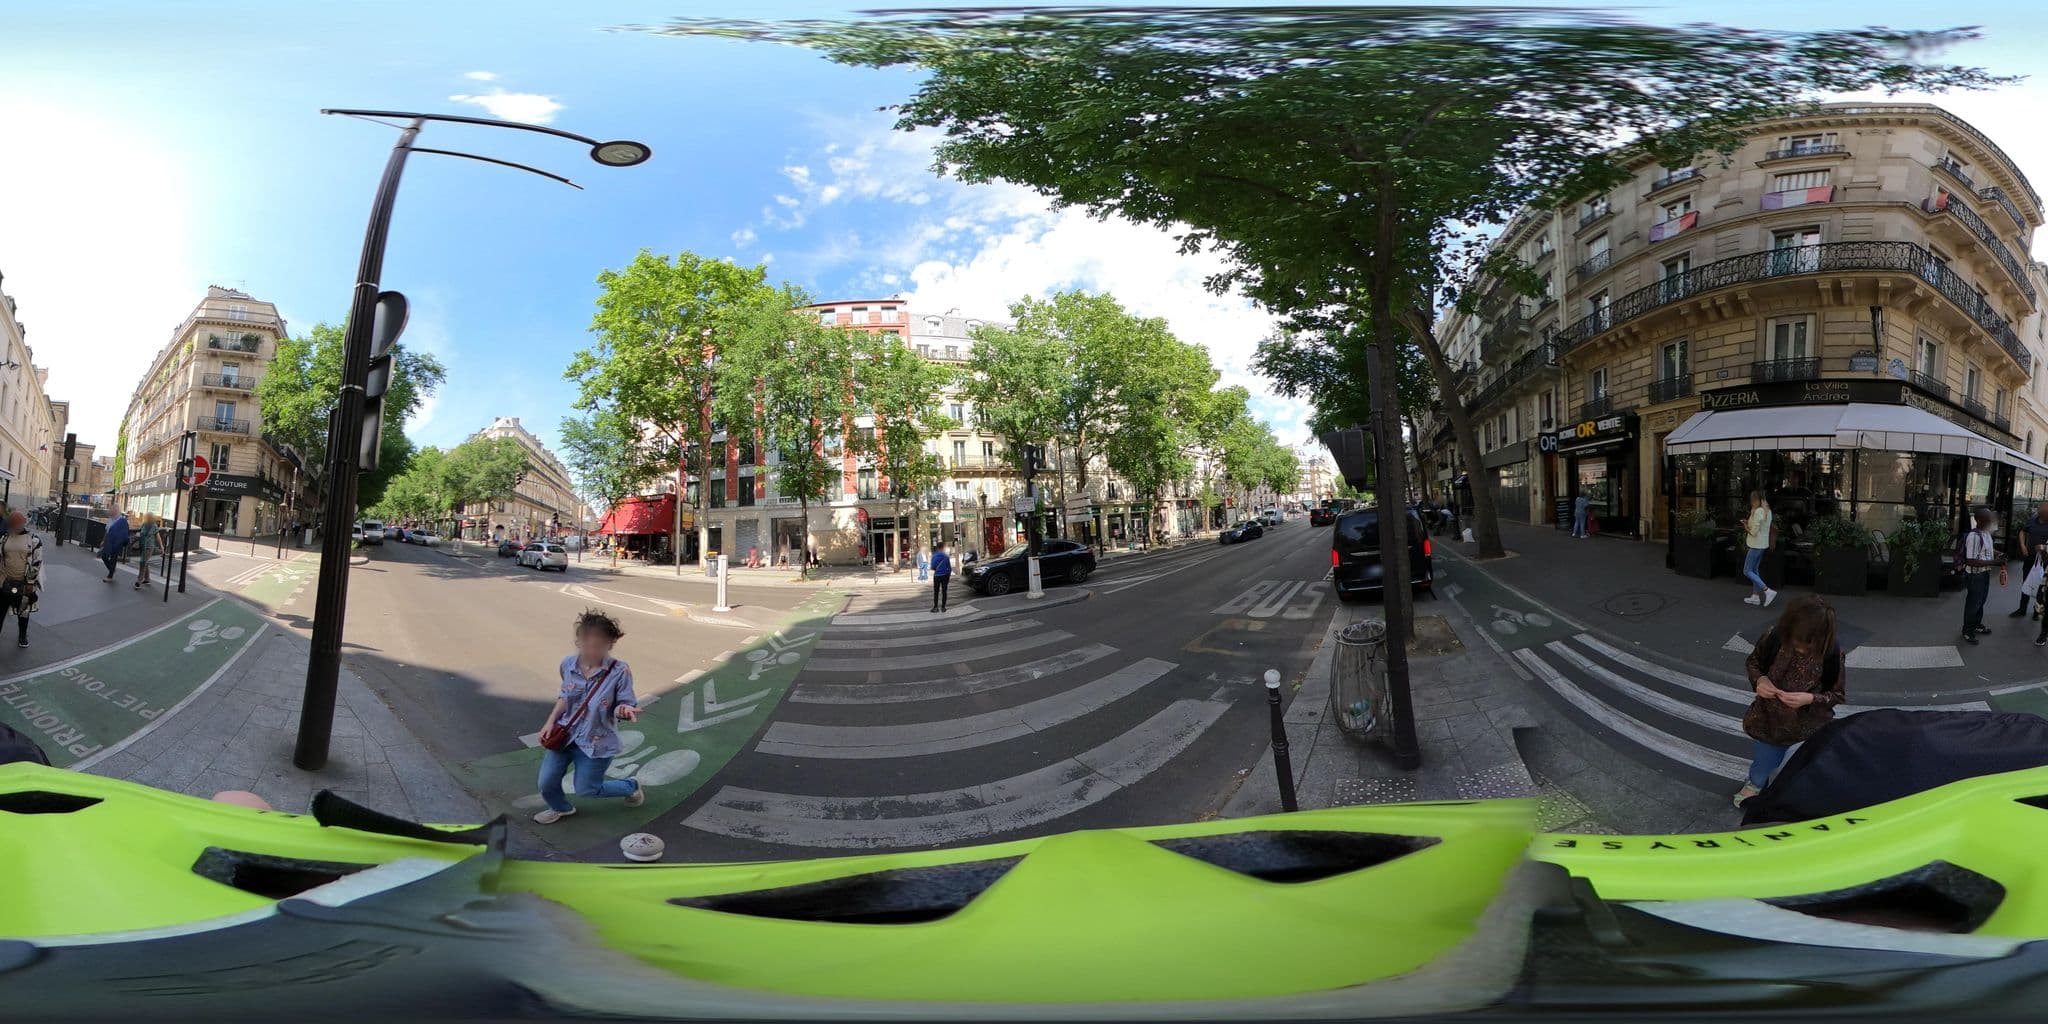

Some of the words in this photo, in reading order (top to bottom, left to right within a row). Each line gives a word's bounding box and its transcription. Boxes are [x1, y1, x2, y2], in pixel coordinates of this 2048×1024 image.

[1805, 381, 1820, 390] La
[1824, 381, 1849, 390] Villa
[1701, 391, 1760, 409] PIZZERIA
[1577, 420, 1596, 438] OR
[1540, 435, 1558, 451] OR
[214, 479, 248, 489] COUTURE
[1209, 580, 1331, 619] BUS
[60, 667, 166, 721] PIETONS
